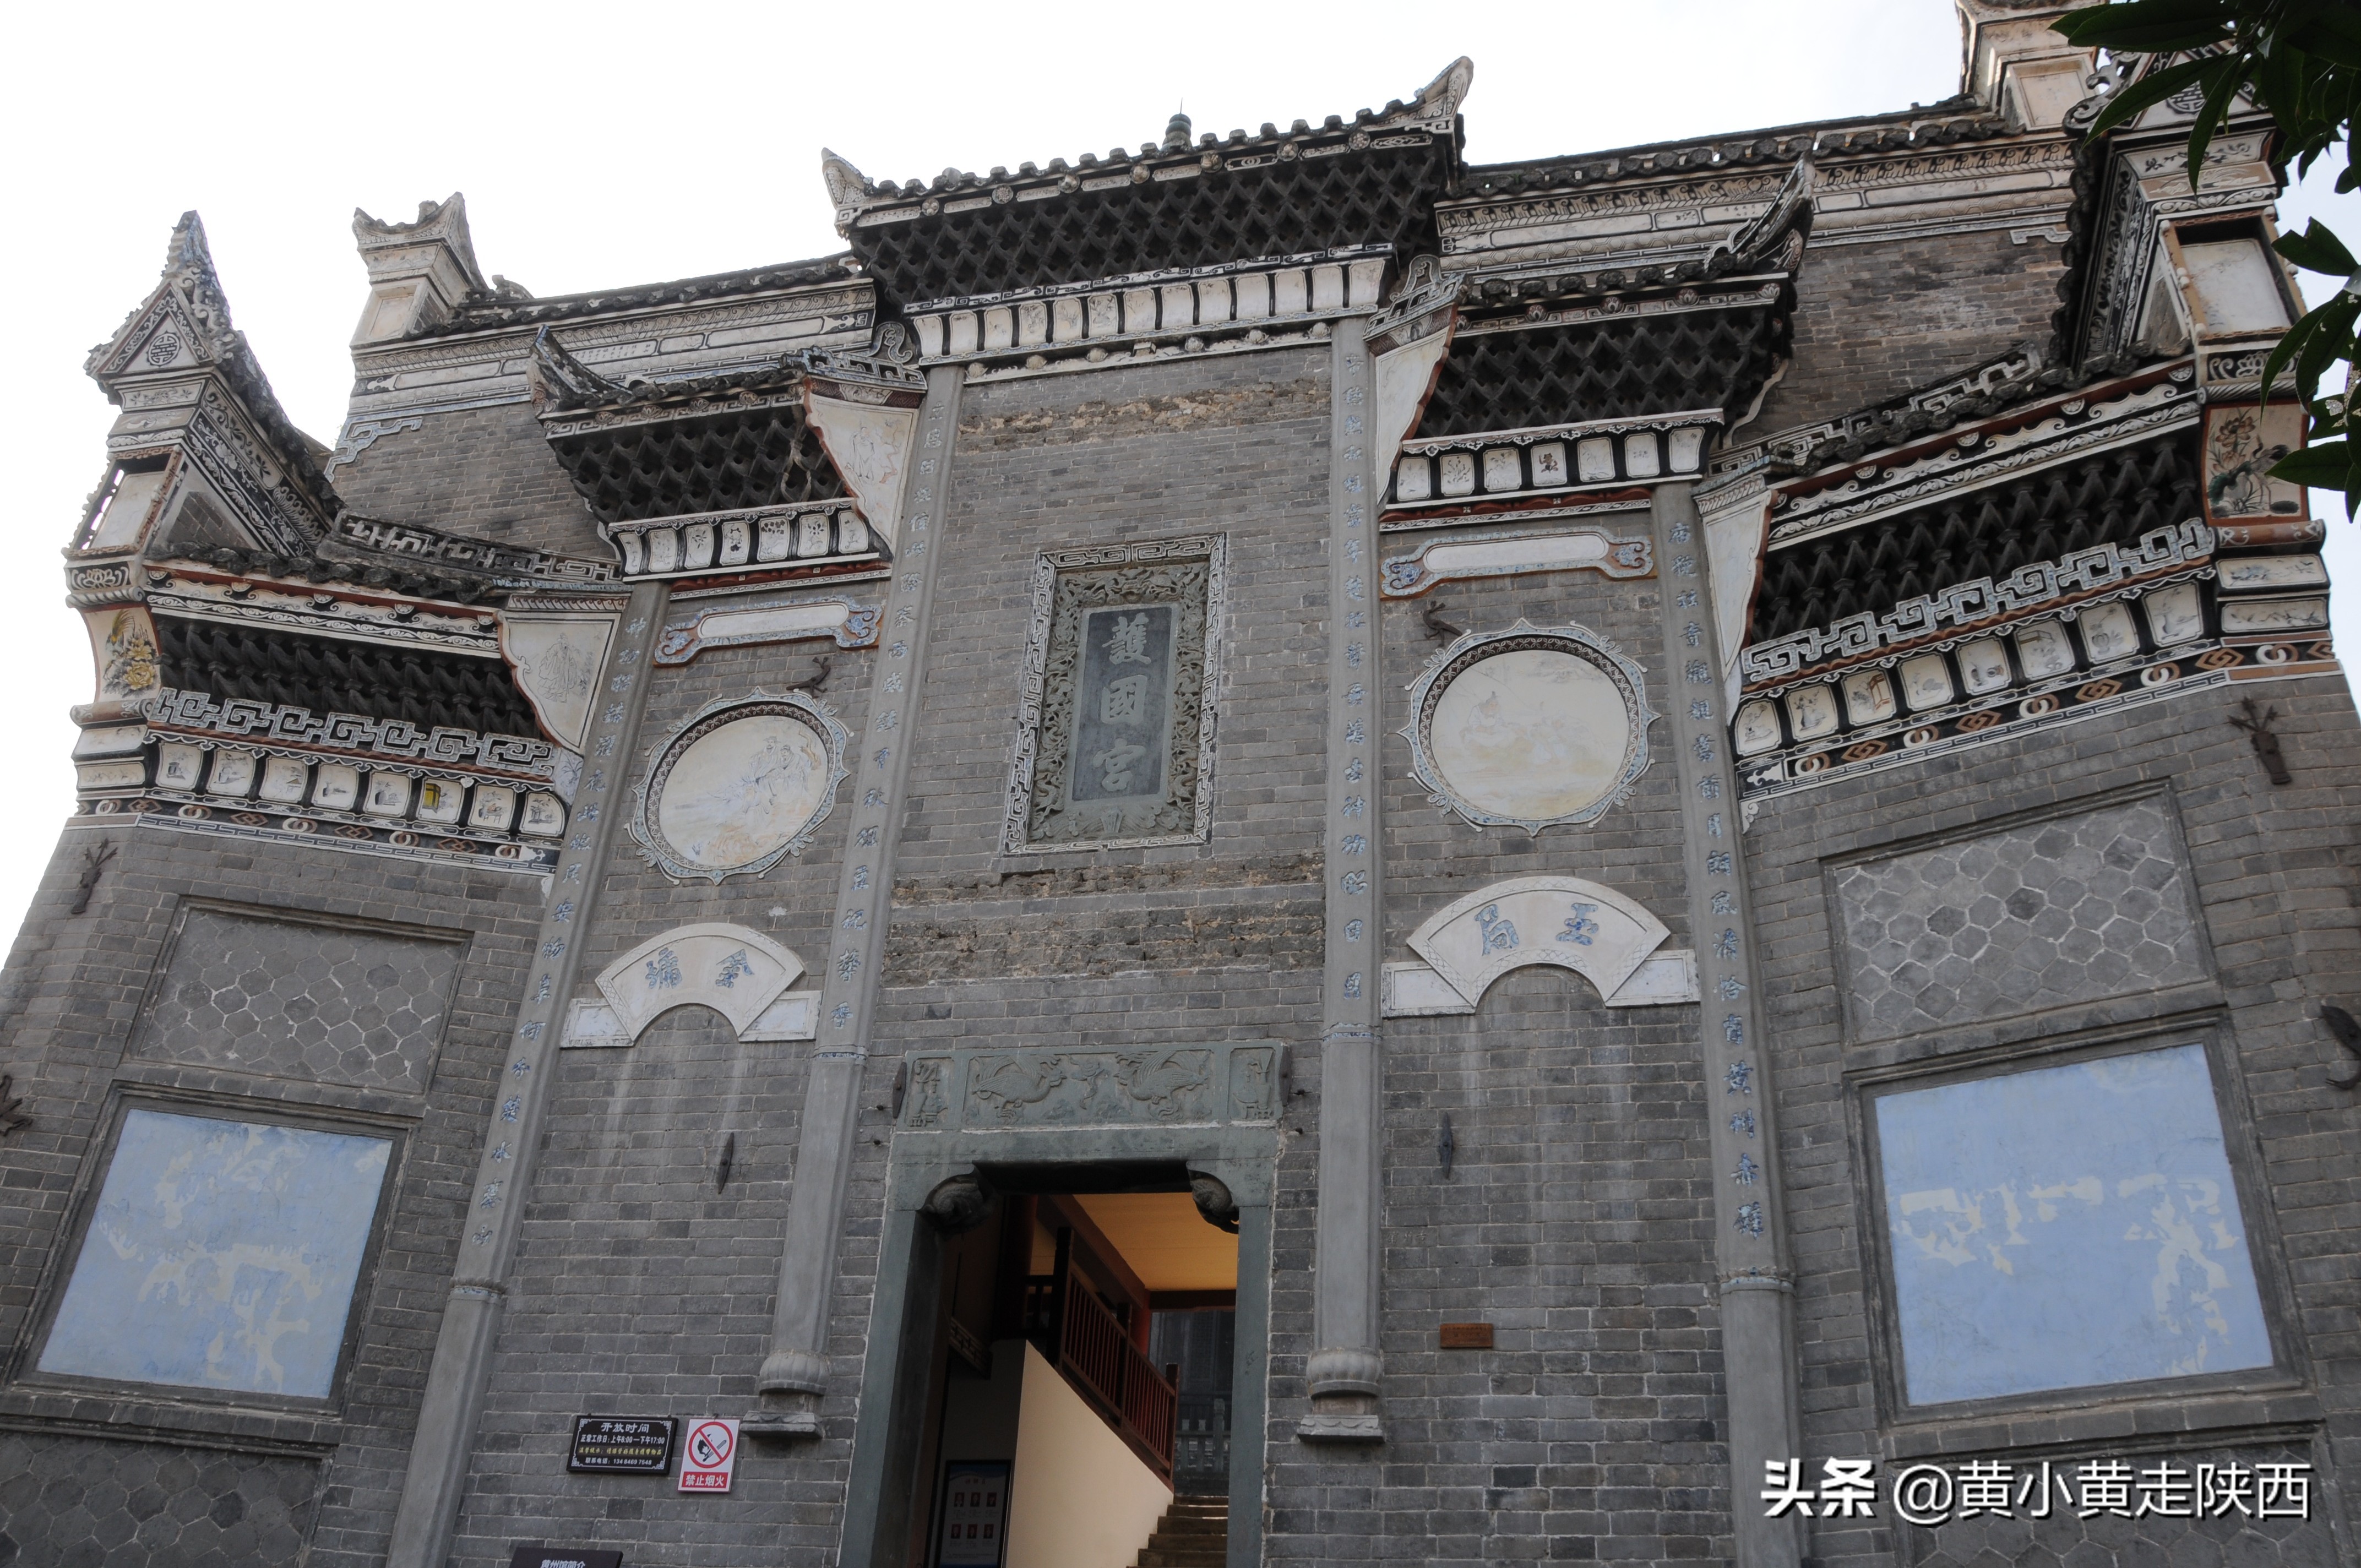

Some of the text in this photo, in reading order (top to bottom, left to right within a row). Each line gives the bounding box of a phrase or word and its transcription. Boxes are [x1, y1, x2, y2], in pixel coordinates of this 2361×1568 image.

[601, 1422, 650, 1433] 开放时间
[685, 1474, 725, 1487] 禁止烟火
